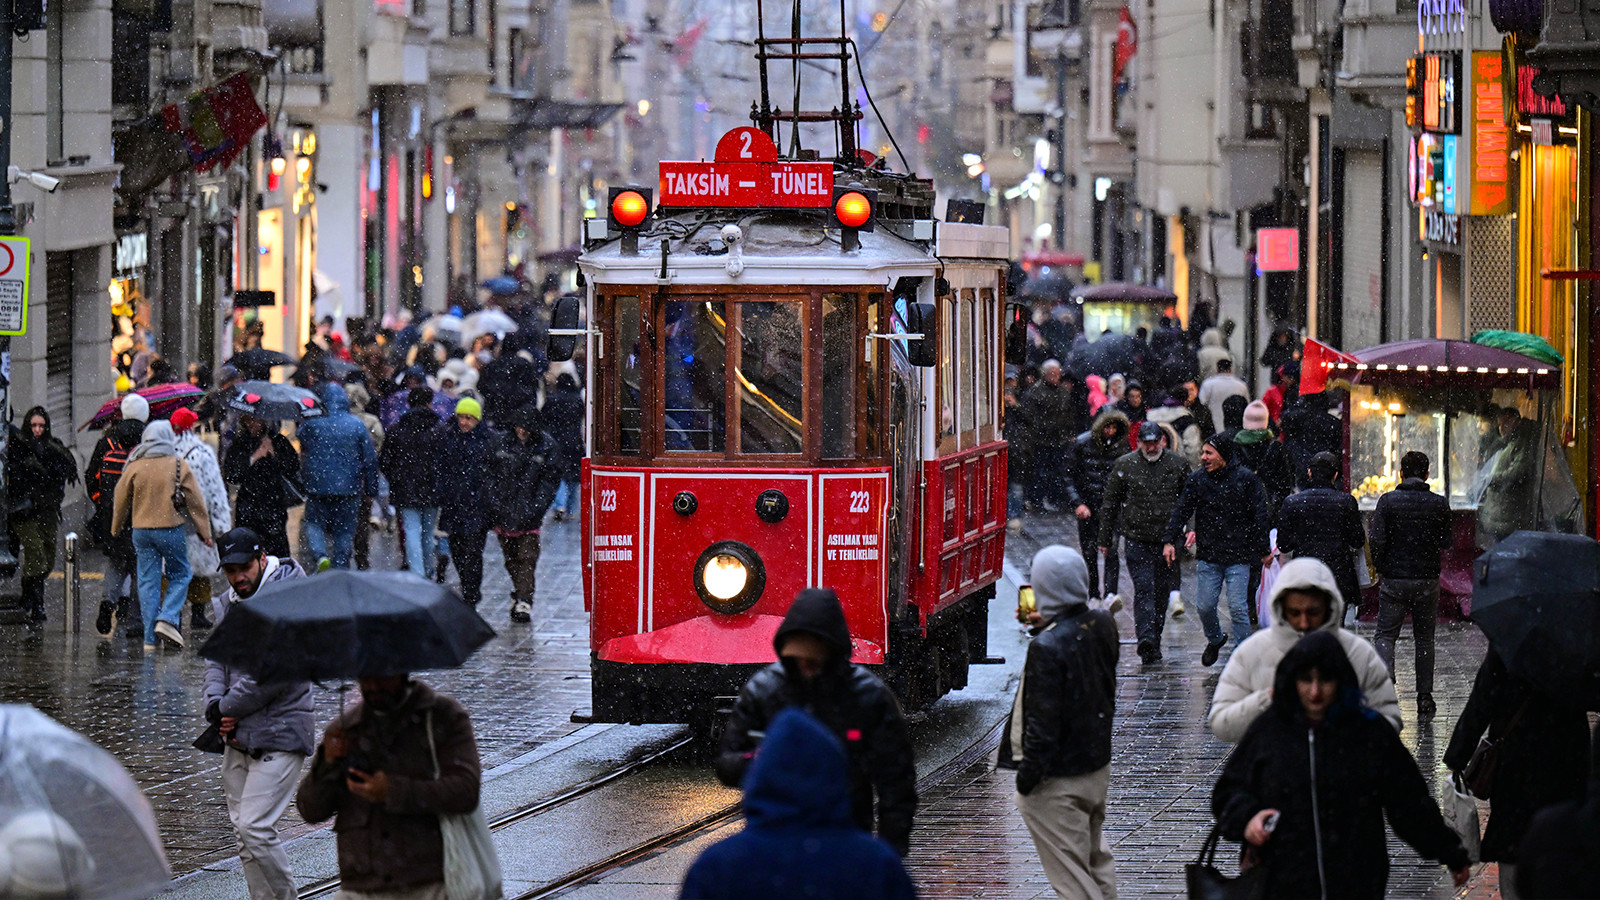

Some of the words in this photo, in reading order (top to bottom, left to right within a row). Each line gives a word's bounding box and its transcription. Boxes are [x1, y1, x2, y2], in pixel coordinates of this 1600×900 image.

[1476, 82, 1507, 182] BOWLING
[740, 131, 753, 158] 2
[666, 167, 729, 196] TAKSİM
[771, 166, 828, 195] TÜNEL
[601, 489, 617, 511] 223
[850, 490, 869, 513] 223
[610, 534, 633, 546] YASAK
[827, 534, 861, 546] ASILMAK
[827, 549, 837, 561] VE
